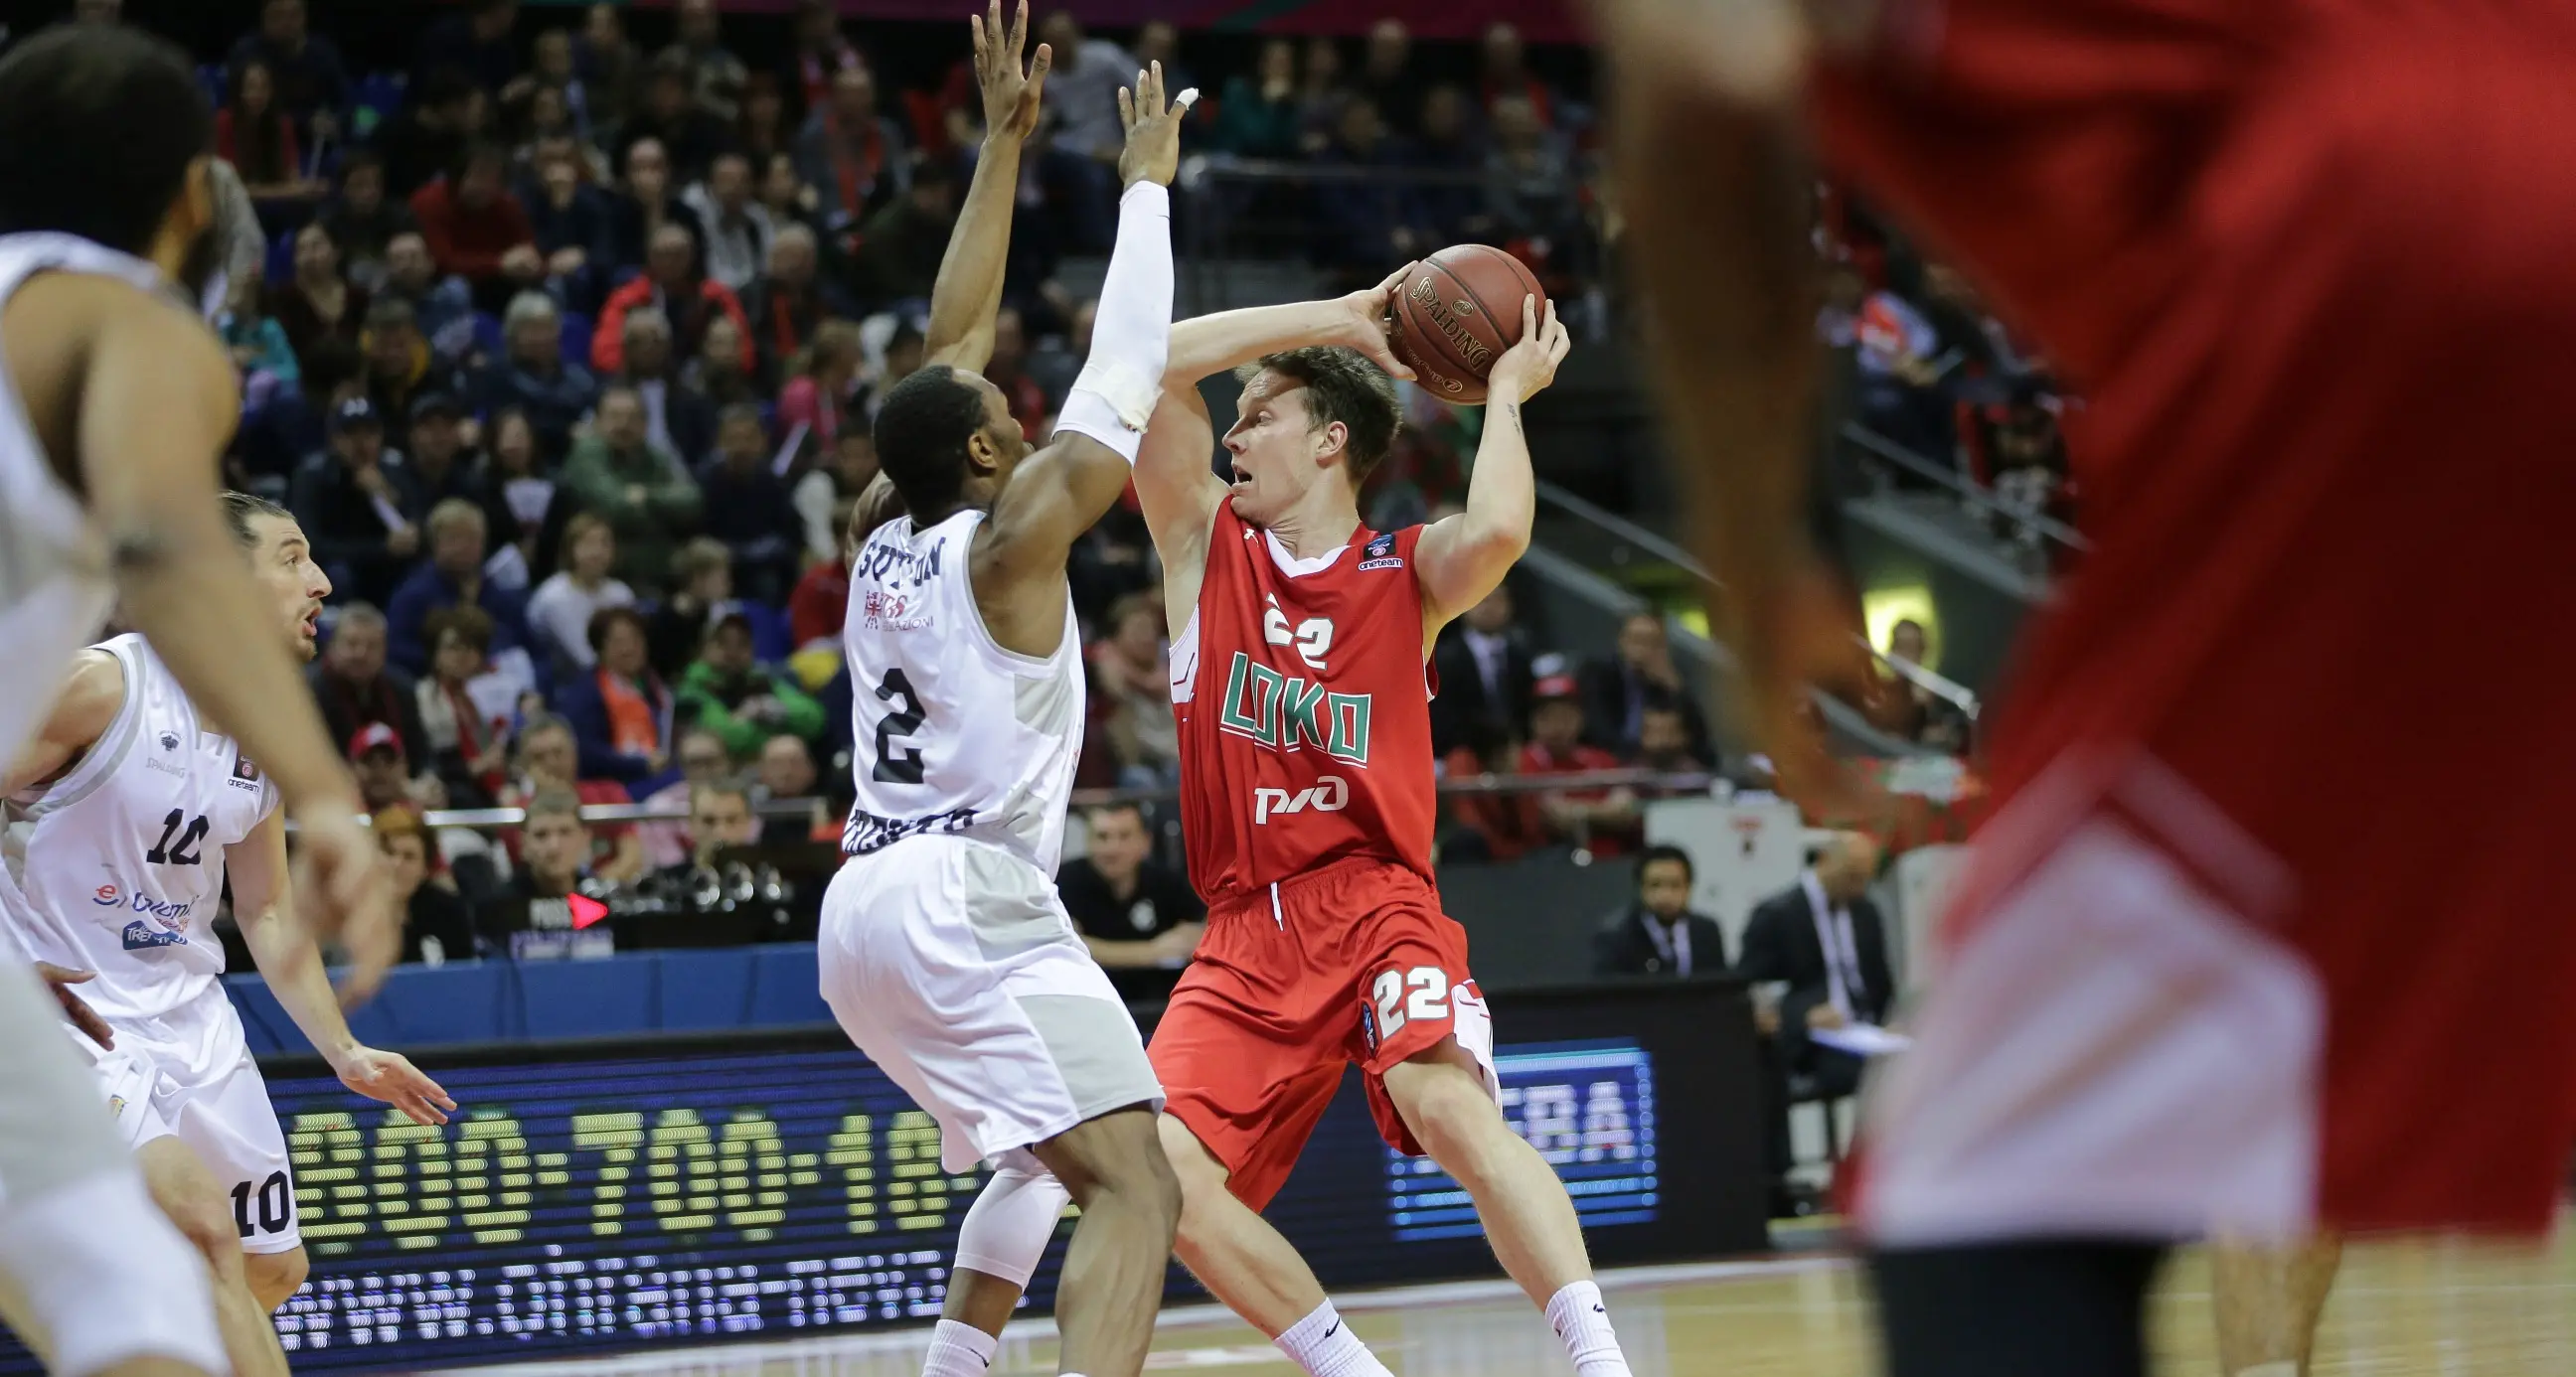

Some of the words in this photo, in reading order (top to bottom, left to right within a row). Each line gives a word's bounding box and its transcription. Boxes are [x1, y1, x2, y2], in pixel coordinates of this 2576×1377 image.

[1410, 277, 1492, 371] SPALDING
[1359, 558, 1403, 570] oneteam
[1263, 591, 1335, 671] 22
[873, 668, 926, 784] 2
[1219, 650, 1372, 765] LOKO
[228, 778, 260, 794] oneteam
[146, 808, 210, 865] 10
[1372, 965, 1449, 1041] 22
[233, 1169, 290, 1238] 10
